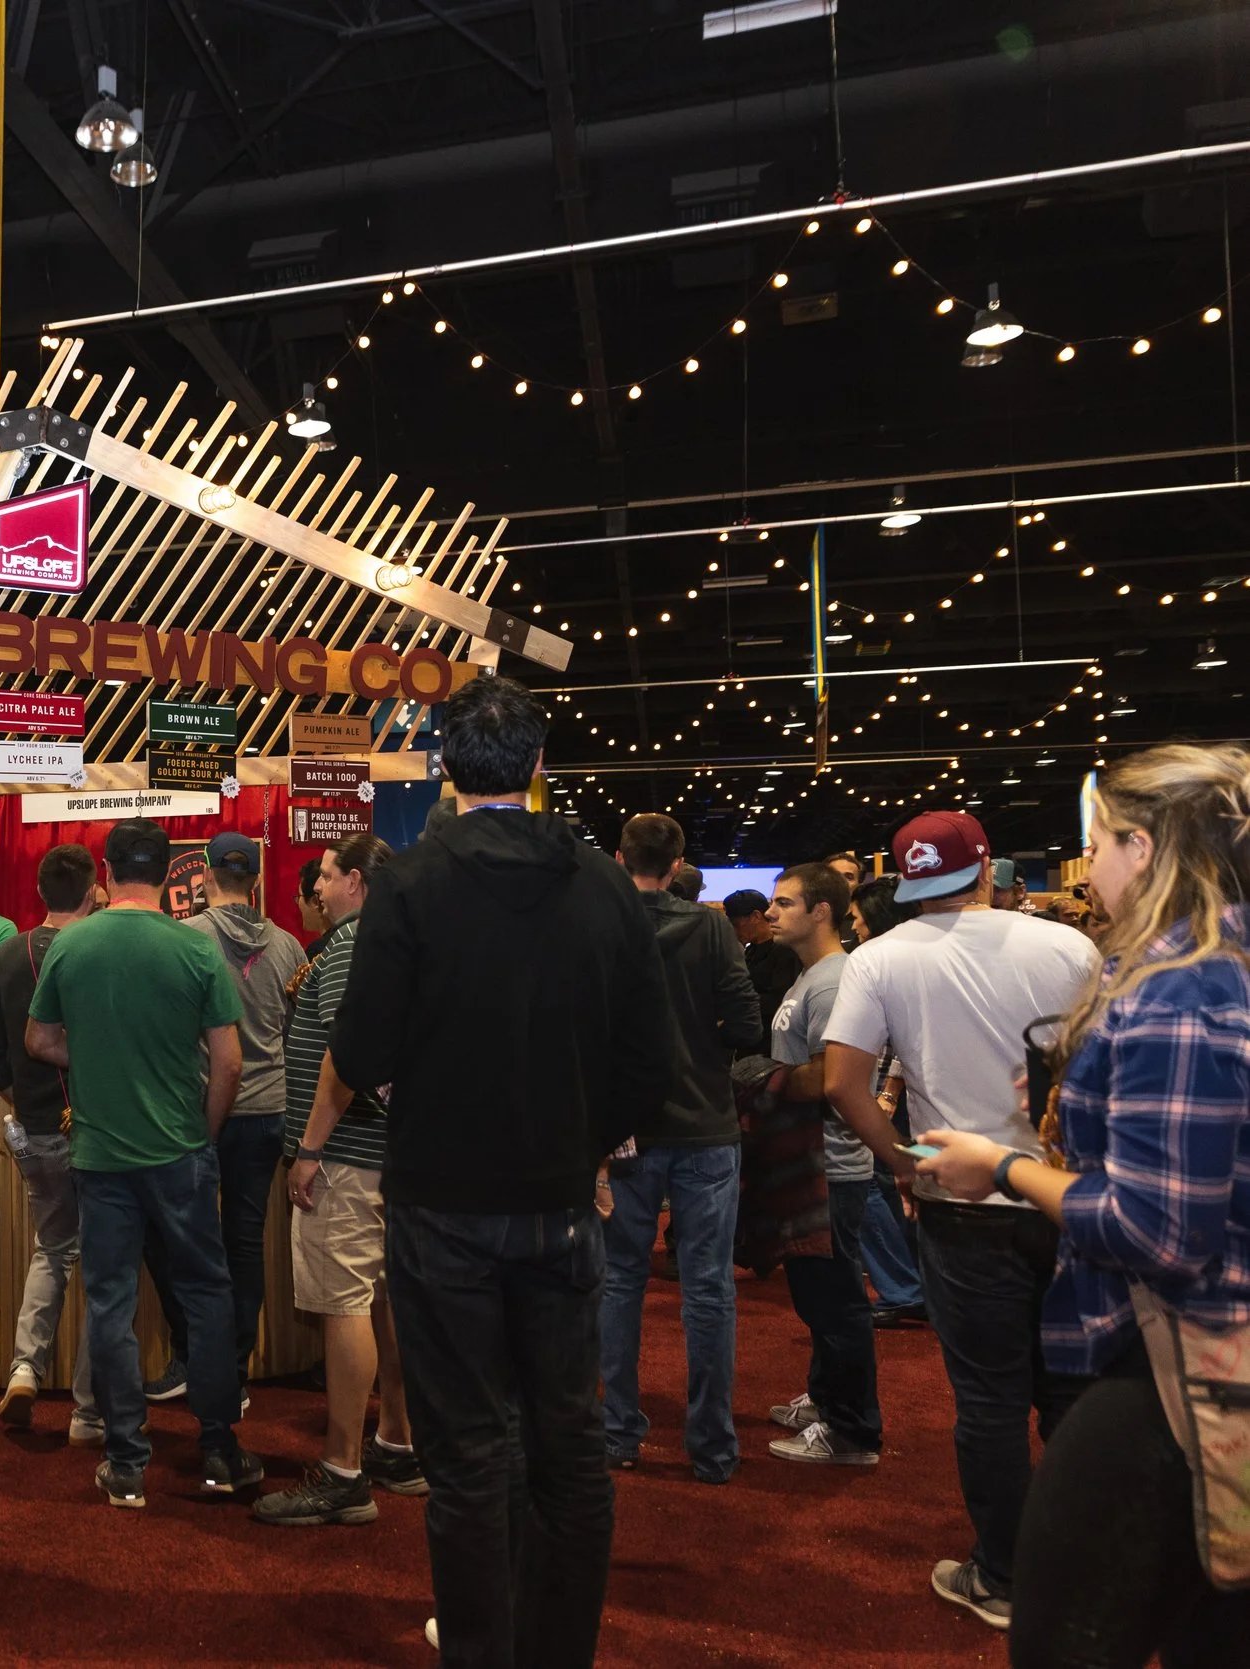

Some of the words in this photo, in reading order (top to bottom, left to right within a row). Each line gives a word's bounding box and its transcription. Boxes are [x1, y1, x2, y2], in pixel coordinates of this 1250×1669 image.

[1, 553, 74, 575] UPSLOPE
[1, 567, 35, 577] BREWING
[37, 571, 73, 580] COMPANY
[349, 642, 453, 705] CO
[31, 705, 55, 716] PALE
[58, 706, 76, 717] ALE
[167, 713, 200, 725] BROWN
[203, 716, 220, 726] ALE
[304, 725, 342, 736] PUMPKIN
[345, 727, 360, 736] ALE
[7, 755, 43, 765] LYCHEE
[47, 756, 64, 765] IPA
[166, 758, 220, 770] FOEDER-AGED
[157, 767, 188, 777] GOLDEN
[190, 769, 212, 779] SOUR
[214, 771, 228, 779] ALE
[306, 771, 333, 781] BATCH
[336, 773, 357, 782] 1000
[67, 798, 98, 810] UPSLOPE
[99, 797, 133, 808] BREWING
[135, 795, 172, 807] COMPANY
[311, 812, 336, 821] PROUD
[337, 813, 347, 822] TO
[349, 814, 359, 822] BE
[311, 822, 369, 831] INDEPENDENTLY
[311, 830, 342, 839] BREWED
